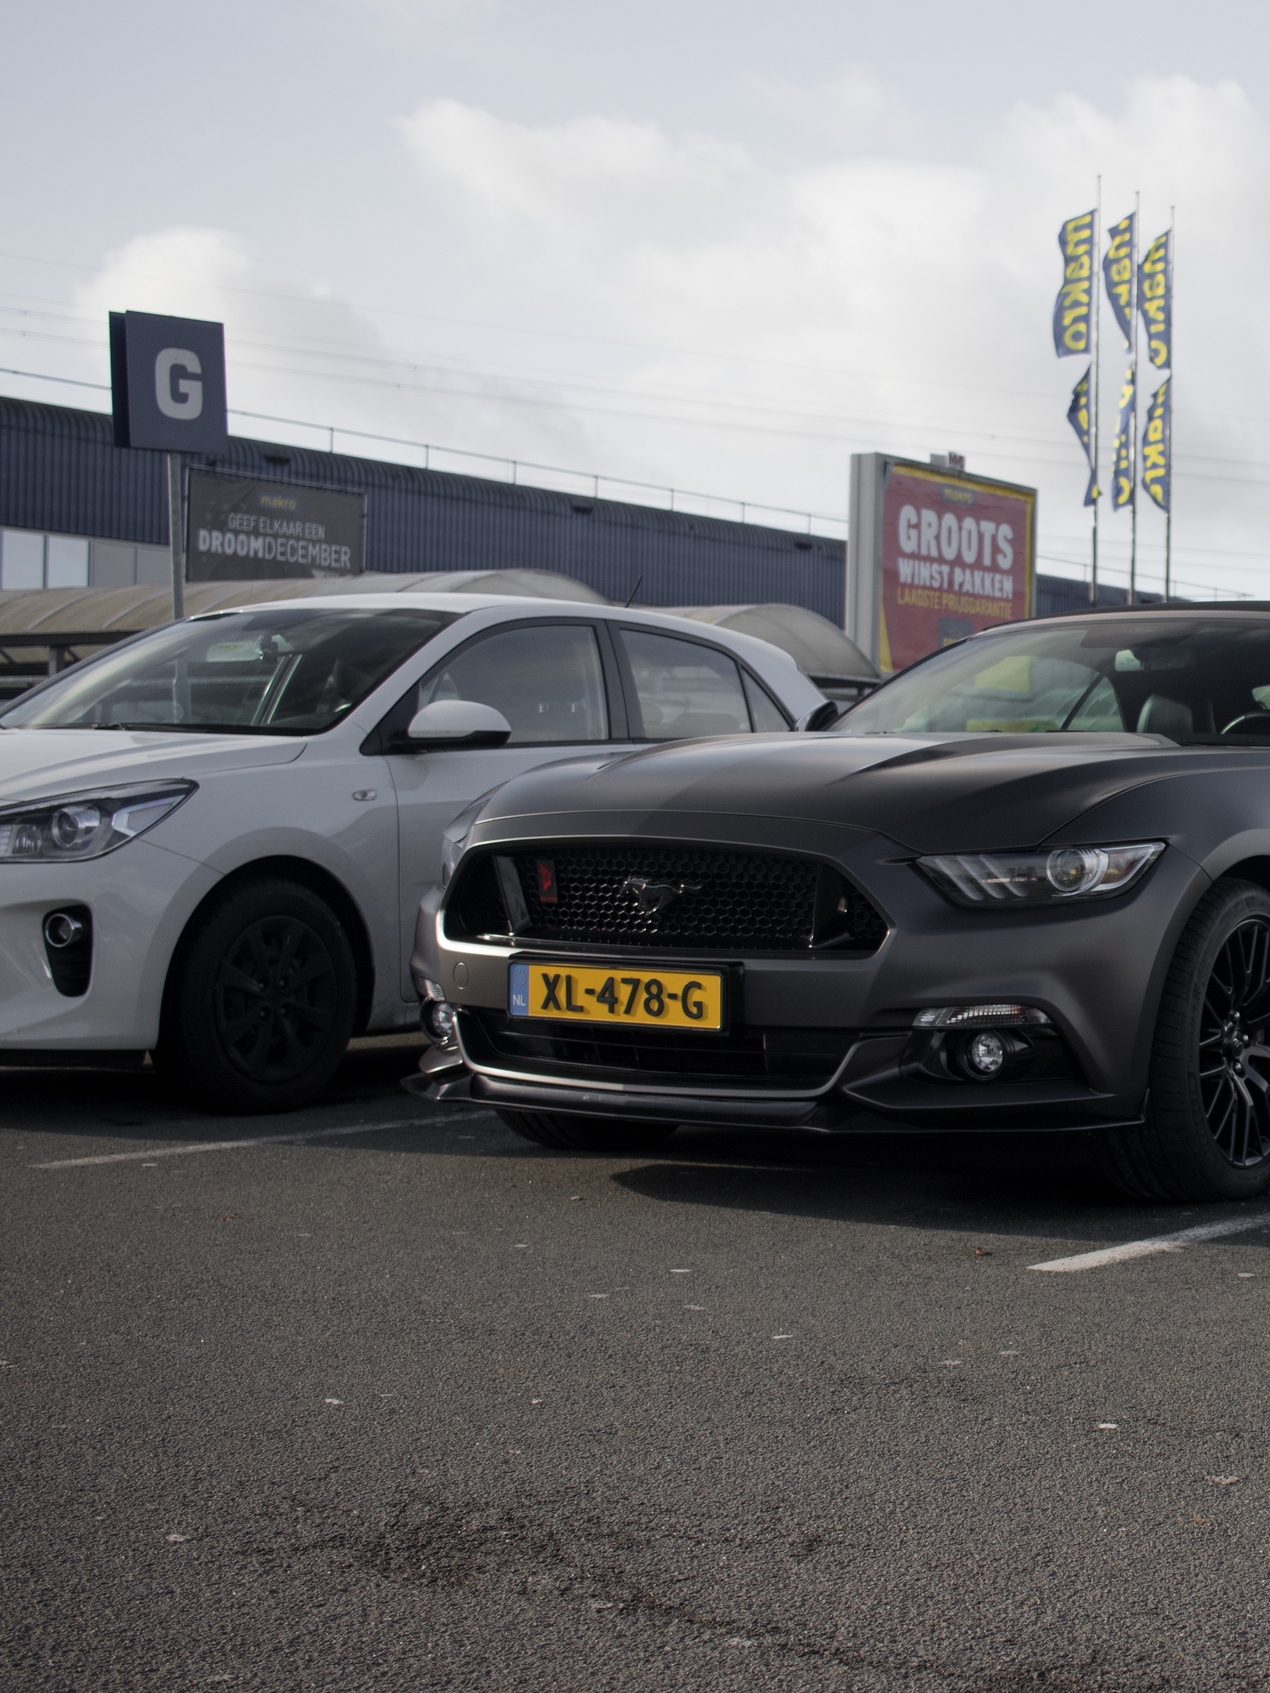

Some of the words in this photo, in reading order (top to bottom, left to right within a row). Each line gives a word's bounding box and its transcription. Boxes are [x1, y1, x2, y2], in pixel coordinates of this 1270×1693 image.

[155, 347, 203, 421] G
[260, 495, 296, 511] makro
[944, 488, 973, 504] makro
[228, 512, 257, 532] GEEF
[259, 516, 302, 536] ELKAAR
[305, 521, 325, 540] EEN
[898, 504, 1014, 570] GROOTS
[198, 528, 351, 569] DROOMDECEMBER
[898, 557, 950, 590] WINST
[953, 566, 1013, 600] PAKKEN
[897, 586, 940, 610] LAAGSTE
[941, 592, 1012, 620] PRIJSGARANTIE
[512, 994, 526, 1007] NL
[540, 972, 704, 1020] XL-478-G
